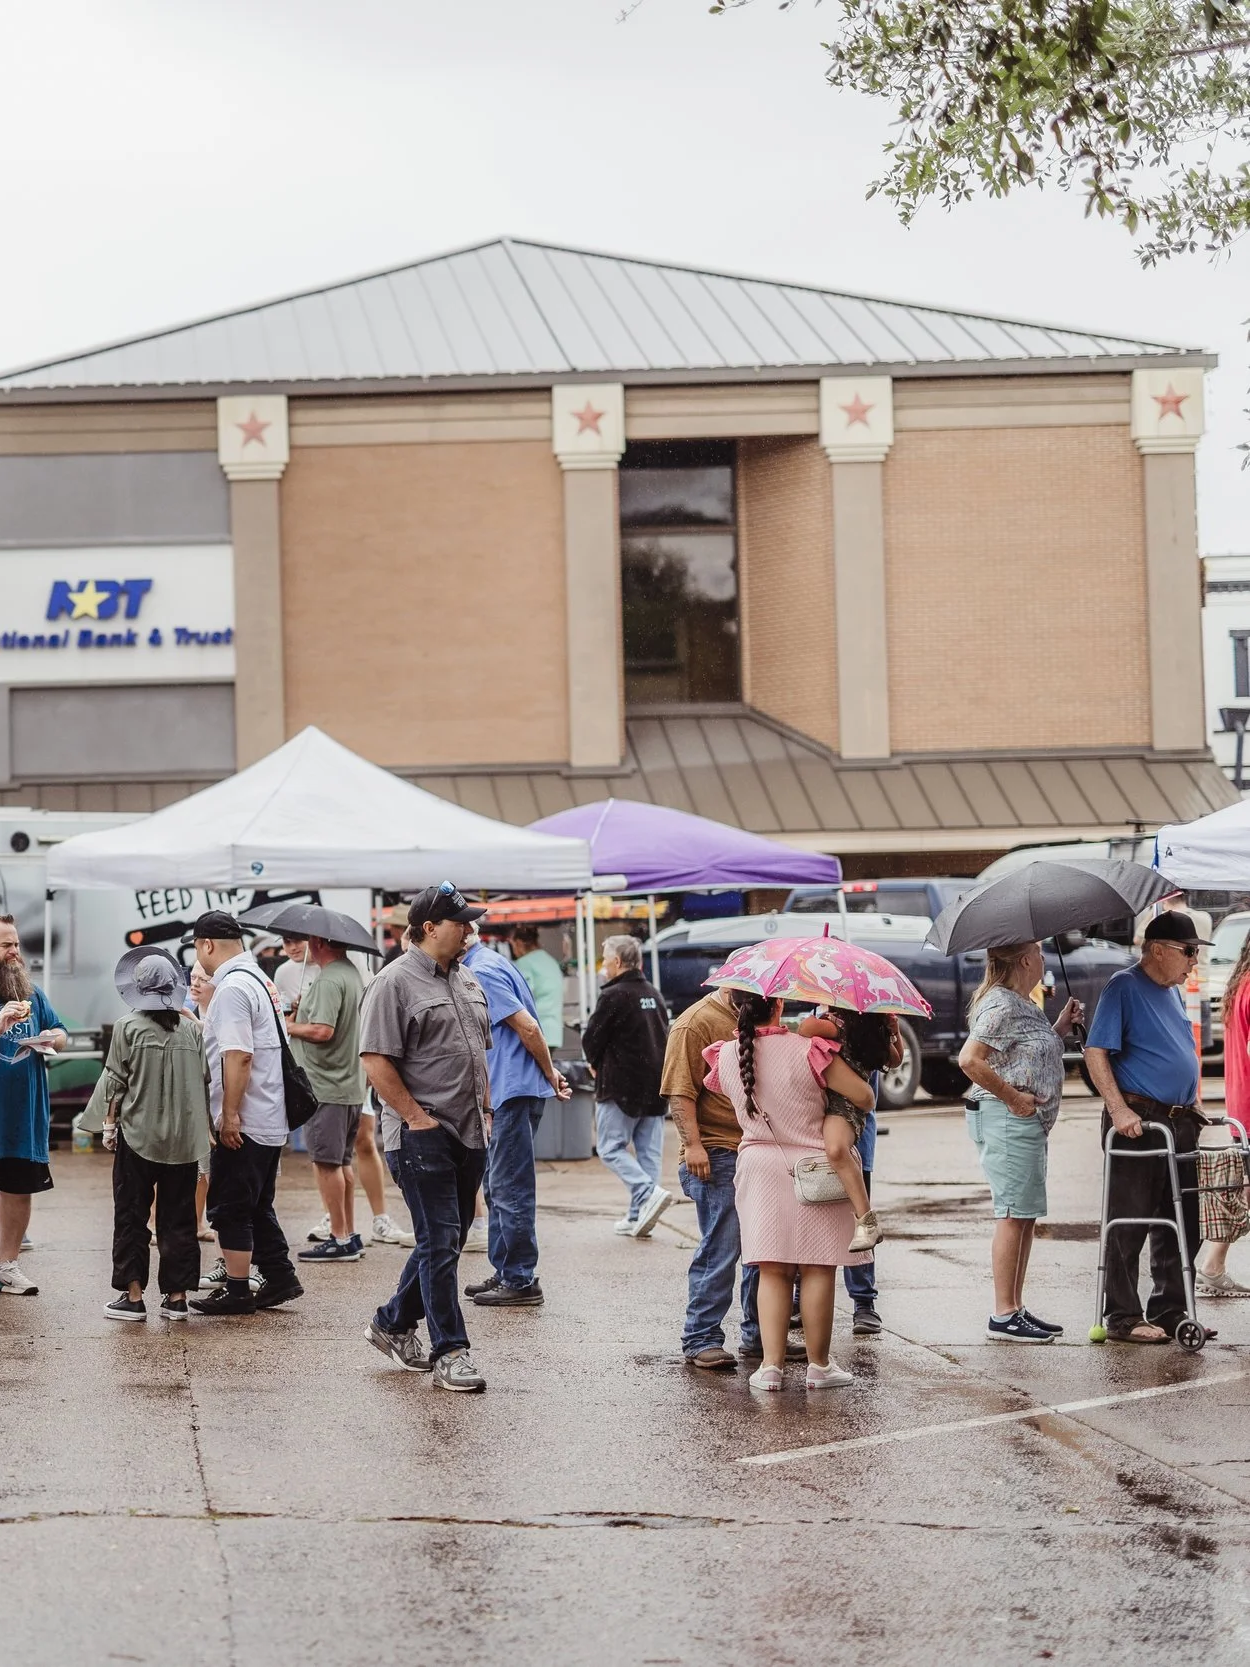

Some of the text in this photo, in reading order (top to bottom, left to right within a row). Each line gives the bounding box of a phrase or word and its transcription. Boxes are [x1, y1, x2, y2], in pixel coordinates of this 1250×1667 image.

[77, 630, 137, 648] Bank
[148, 628, 162, 646] &
[174, 627, 235, 646] Trust
[134, 888, 192, 919] FEED
[5, 1022, 30, 1035] RST
